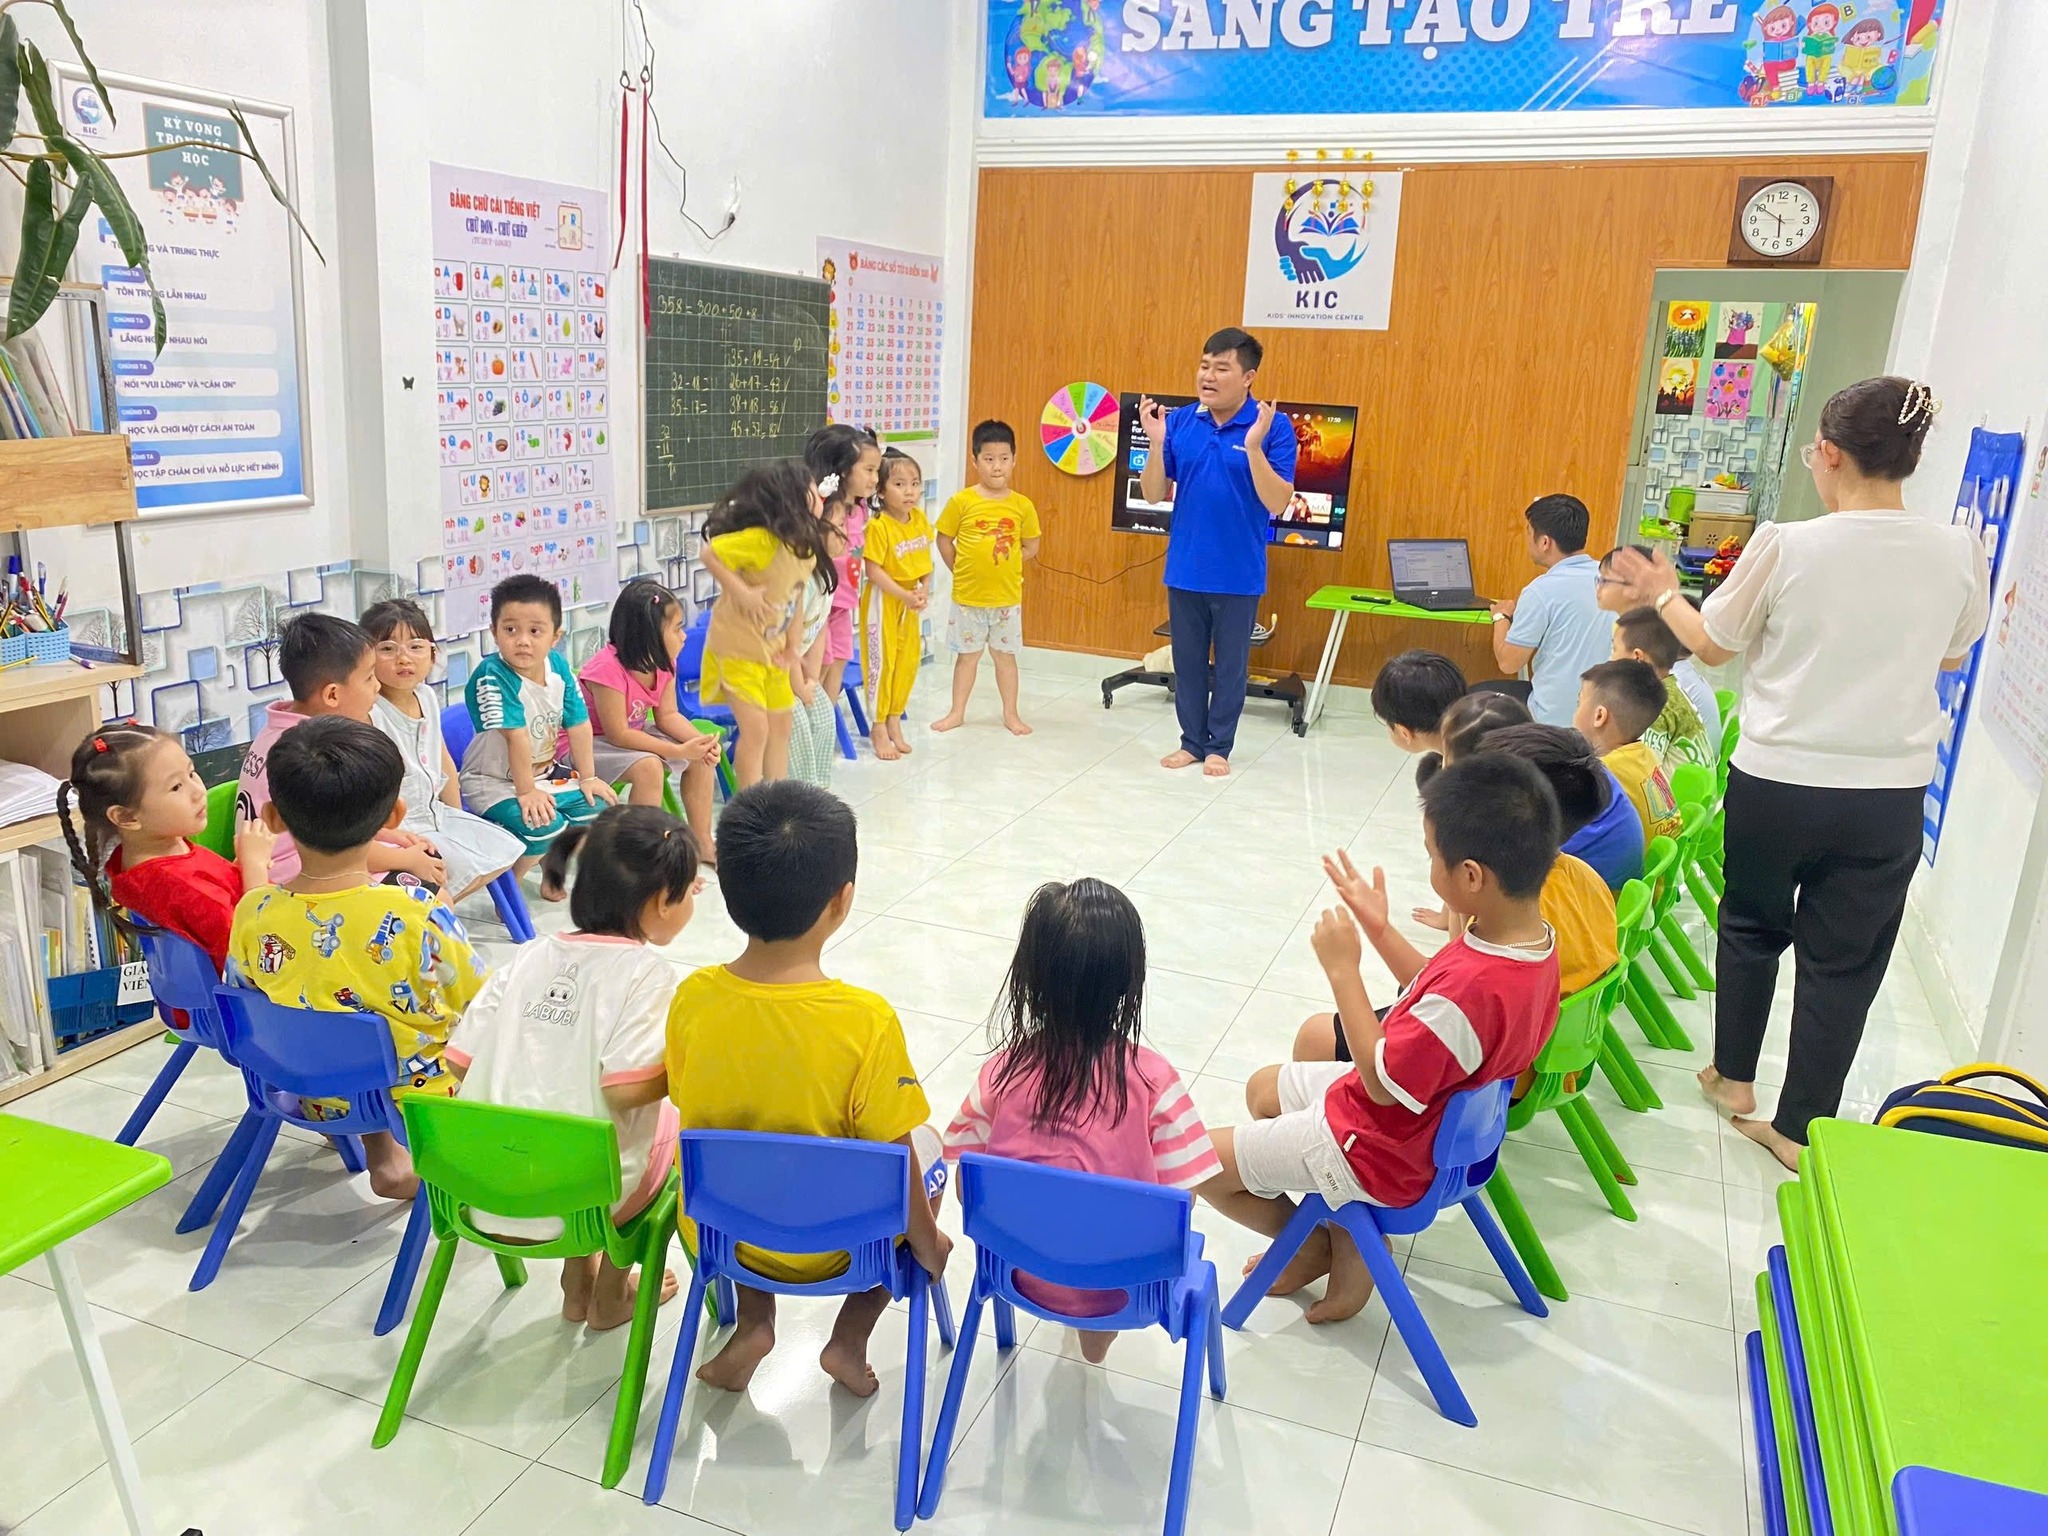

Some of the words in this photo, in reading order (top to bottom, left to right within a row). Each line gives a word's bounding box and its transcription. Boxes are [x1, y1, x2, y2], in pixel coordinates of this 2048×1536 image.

[83, 125, 98, 134] KIC
[184, 120, 222, 137] VỌNG
[181, 151, 209, 167] HỌC
[1766, 194, 1775, 203] 11
[1779, 191, 1789, 200] 12
[1793, 194, 1798, 203] 1
[450, 188, 471, 210] BẢNG
[473, 194, 489, 212] CHỮ
[490, 196, 502, 214] CÁI
[504, 196, 525, 216] TIẾNG
[526, 201, 541, 221] VIỆT
[1800, 203, 1808, 212] 2
[1750, 215, 1757, 224] 9
[1802, 216, 1810, 225] 3
[466, 216, 479, 233] CHỮ
[498, 220, 511, 236] CHỮ
[512, 221, 528, 238] GHÉP
[1752, 228, 1759, 237] 8
[1796, 228, 1803, 237] 4
[1760, 238, 1768, 246] 7
[1772, 240, 1780, 250] 6
[1786, 238, 1793, 247] 5
[156, 244, 168, 254] VÀ
[170, 246, 198, 256] TRUNG
[199, 248, 220, 259] THỰC
[444, 265, 450, 278] A
[116, 286, 134, 296] TÔN
[135, 288, 165, 299] TRỌG
[184, 291, 207, 300] NHAU
[1296, 290, 1338, 309] KIC
[696, 299, 720, 316] 300
[444, 308, 451, 319] D
[169, 336, 192, 344] NHAU
[445, 351, 451, 363] H
[520, 351, 526, 362] K
[124, 380, 139, 389] NÓI
[187, 380, 200, 388] VÀ
[447, 391, 454, 403] N
[127, 426, 145, 435] HỌC
[147, 425, 159, 434] VÀ
[160, 425, 180, 433] CHƠI
[182, 423, 199, 434] MỘT
[200, 423, 221, 432] CÁCH
[235, 422, 254, 431] TOÀN
[448, 435, 456, 447] Q
[151, 470, 166, 479] TẬP
[206, 464, 217, 474] VÀ
[457, 517, 469, 528] Nh
[476, 675, 504, 730] LABUBU
[522, 1002, 580, 1027] LABUBU
